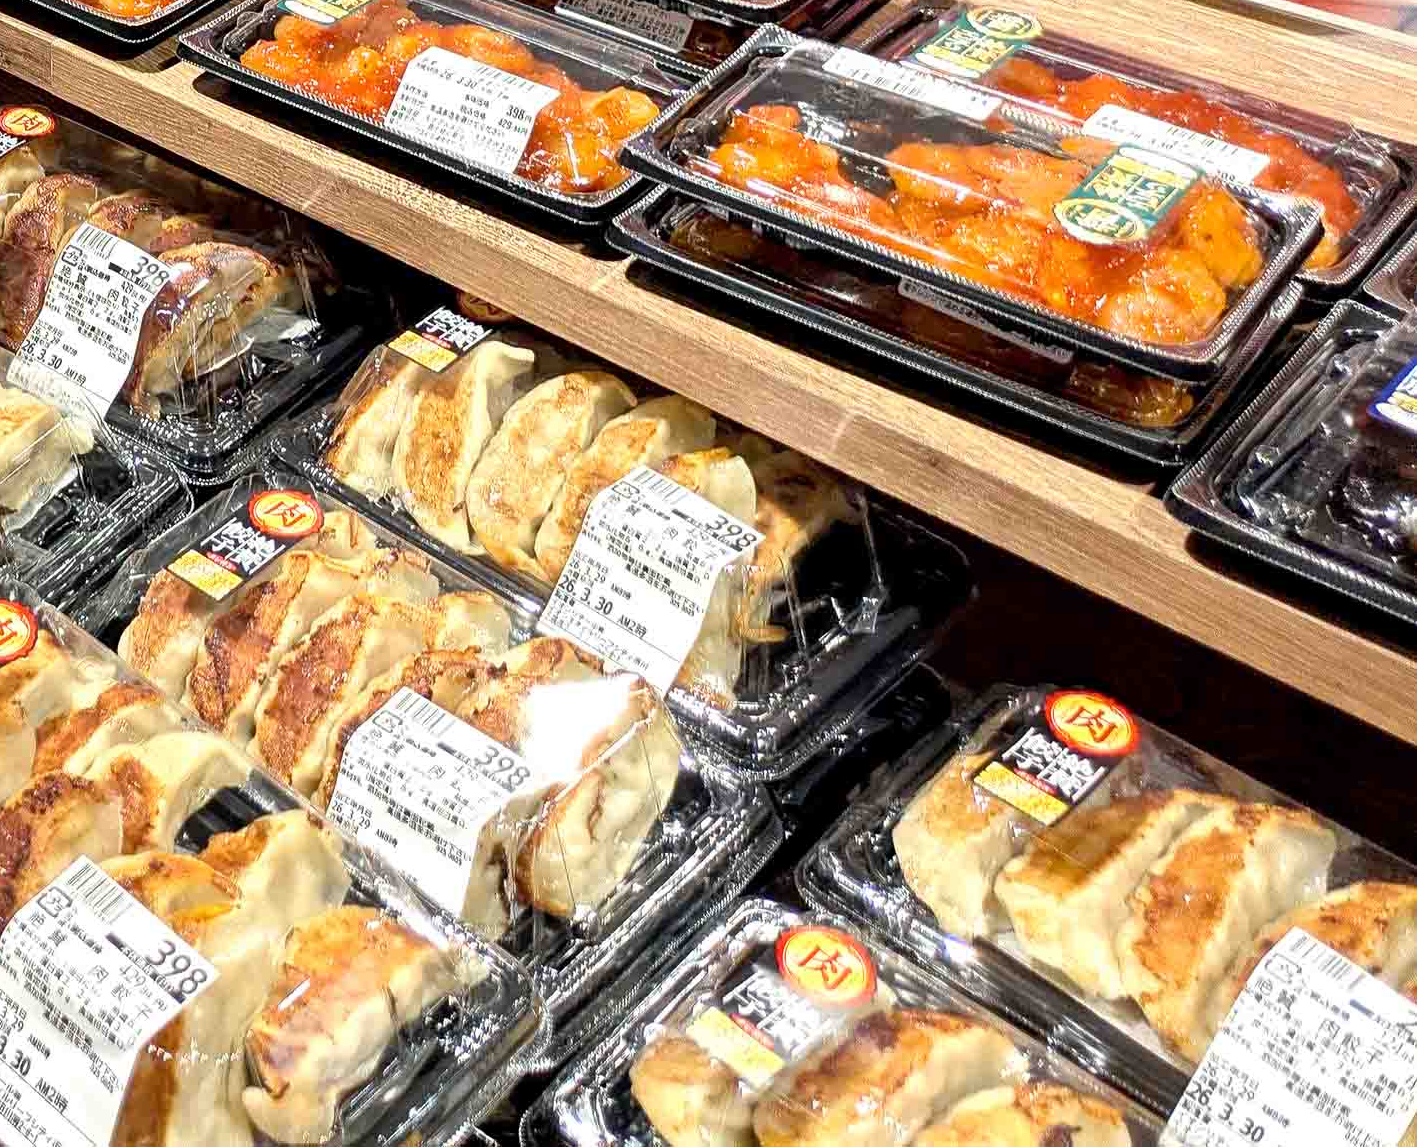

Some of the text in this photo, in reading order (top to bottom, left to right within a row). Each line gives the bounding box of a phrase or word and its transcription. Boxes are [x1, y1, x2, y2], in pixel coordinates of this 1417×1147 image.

[131, 255, 170, 286] 398
[21, 340, 63, 370] 26.3.30
[705, 514, 758, 549] 398
[568, 557, 607, 585] 26.3.29
[557, 573, 648, 639] 26.3.30 AM2時
[474, 744, 532, 787] 398
[331, 800, 372, 830] 26.3.29
[143, 938, 210, 997] 398
[87, 964, 154, 1022] 肉餃子
[34, 1076, 71, 1116] AM2時
[1185, 1081, 1266, 1142] 26.3.30
